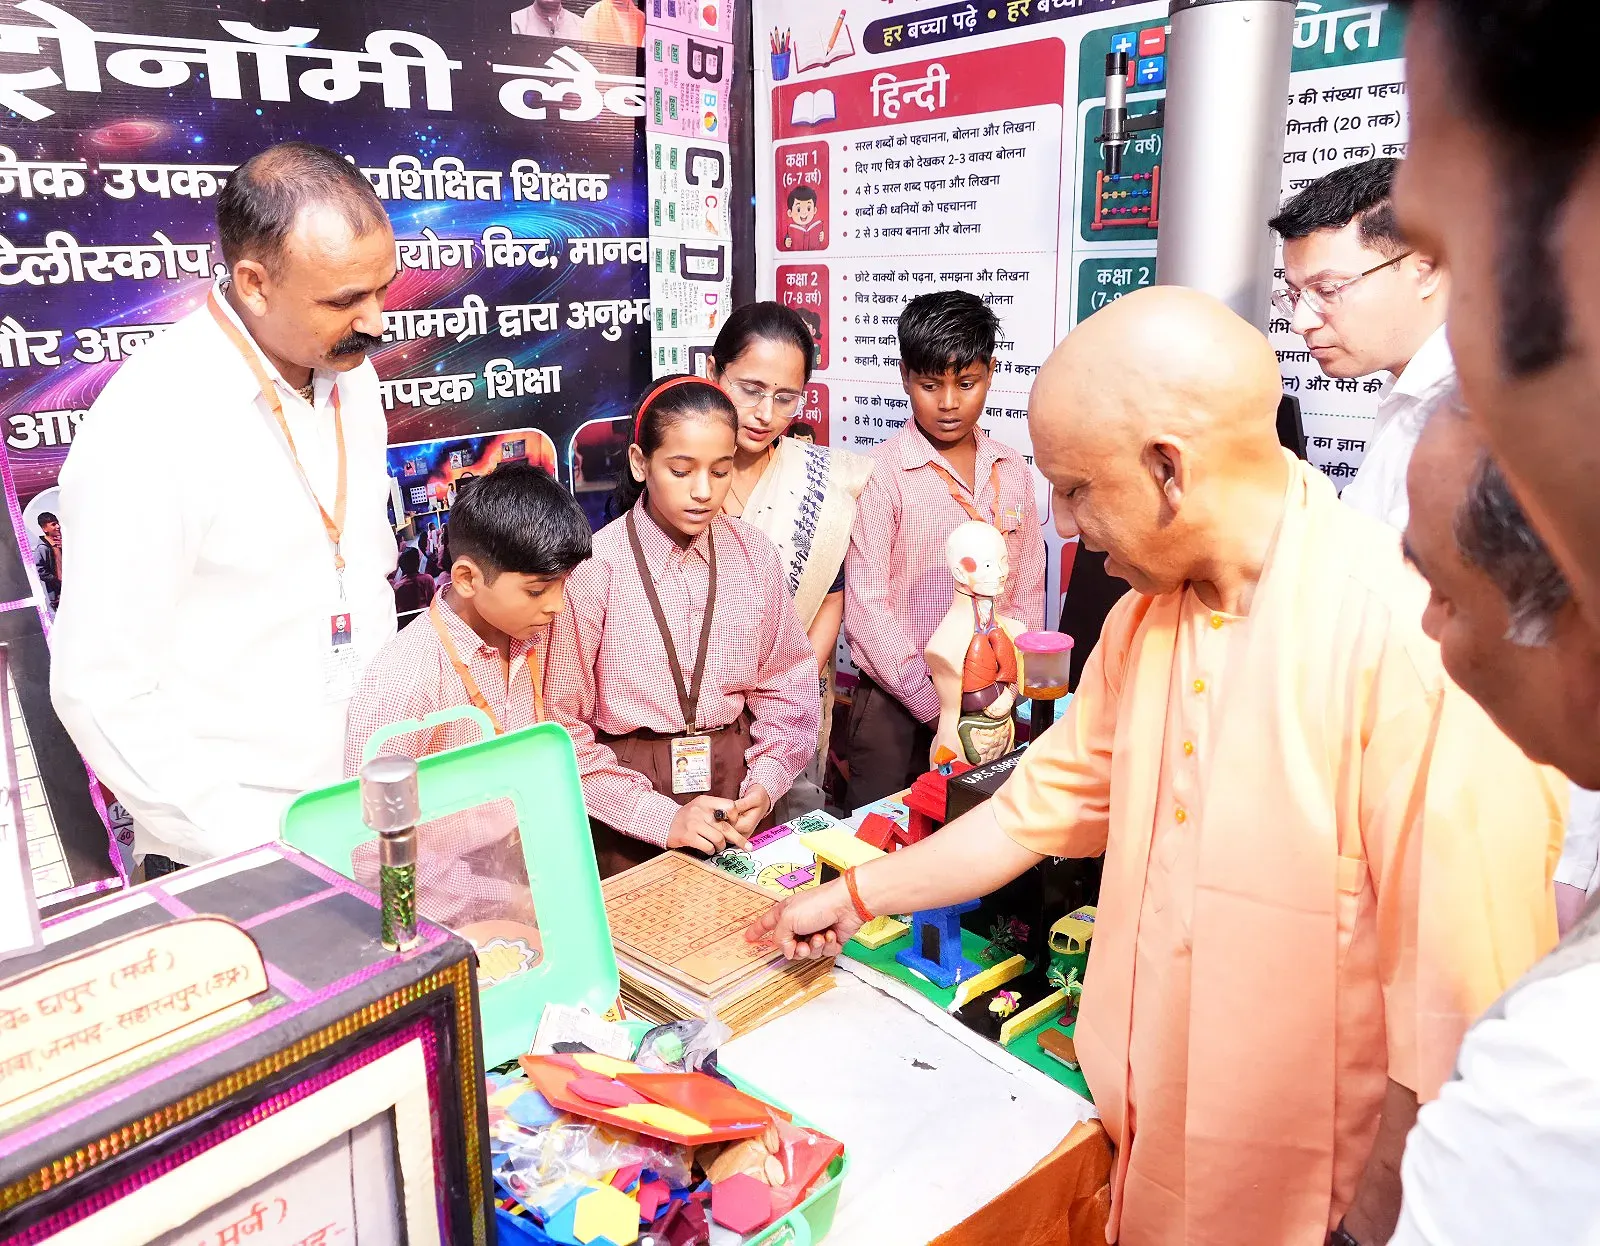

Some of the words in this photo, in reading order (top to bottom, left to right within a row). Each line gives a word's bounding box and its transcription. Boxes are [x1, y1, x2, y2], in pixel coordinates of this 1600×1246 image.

[883, 26, 902, 47] हर
[908, 16, 947, 39] बच्चा
[952, 8, 978, 32] पढ़े
[1006, 0, 1029, 22] हर
[1292, 1, 1389, 54] णित
[687, 38, 723, 83] B
[704, 94, 716, 107] B
[870, 63, 950, 119] हिन्दी
[1299, 88, 1318, 105] की
[1322, 87, 1363, 102] संख्या
[1287, 116, 1328, 135] गिनती
[1334, 116, 1361, 133] (20
[1368, 110, 1400, 128] तक)
[855, 141, 873, 150] सरल
[876, 136, 894, 149] शब्दों
[897, 134, 907, 146] को
[910, 132, 948, 145] पहचानना,
[953, 127, 980, 139] बोलना
[983, 123, 1000, 136] और
[1003, 121, 1035, 134] लिखना
[1135, 134, 1162, 156] वर्ष)
[786, 153, 808, 168] कक्षा
[812, 150, 817, 164] 1
[855, 162, 868, 173] दिए
[872, 163, 882, 172] गए
[885, 159, 900, 170] चित्र
[903, 156, 914, 168] को
[917, 155, 945, 167] देखकर
[949, 154, 965, 164] 2-3
[969, 151, 992, 162] वाक्य
[996, 147, 1025, 159] बोलना
[1313, 148, 1337, 164] (10
[1344, 143, 1375, 159] तक)
[685, 147, 724, 189] C
[99, 163, 238, 199] उपक
[510, 158, 610, 201] शिक्षक
[782, 173, 803, 187] (6-7
[805, 170, 821, 185] वर्ष)
[856, 187, 860, 195] 4
[864, 183, 871, 194] से
[875, 185, 879, 194] 5
[882, 183, 901, 193] सरल
[904, 182, 921, 191] शब्द
[924, 180, 946, 191] पढ़ना
[949, 175, 965, 188] और
[968, 174, 1000, 186] लिखना
[705, 196, 717, 208] C
[856, 205, 874, 216] शब्दों
[877, 204, 887, 215] की
[891, 202, 919, 214] ध्वनियों
[922, 201, 934, 212] को
[937, 201, 977, 212] पहचानना
[856, 229, 860, 238] 2
[863, 227, 870, 238] से
[874, 229, 878, 237] 3
[882, 228, 903, 237] वाक्य
[906, 226, 930, 235] बनाना
[934, 222, 950, 234] और
[953, 222, 981, 233] बोलना
[396, 227, 474, 271] योग
[481, 225, 559, 269] किट,
[680, 244, 724, 282] D
[786, 273, 808, 286] कक्षा
[811, 272, 818, 286] 2
[855, 271, 870, 282] छोटे
[873, 270, 895, 281] वाक्यों
[898, 270, 909, 281] को
[912, 273, 936, 283] पढ़ना,
[940, 273, 973, 282] समझना
[977, 269, 993, 281] और
[996, 269, 1029, 281] लिखना
[1097, 269, 1133, 286] कक्षा
[1138, 266, 1150, 284] 2
[704, 294, 717, 305] D
[783, 291, 803, 305] (7-8
[805, 291, 822, 306] वर्ष)
[855, 292, 869, 303] चित्र
[872, 292, 899, 304] देखकर
[496, 303, 559, 338] द्वारा
[855, 315, 860, 324] 6
[863, 313, 870, 324] से
[873, 316, 878, 324] 8
[855, 336, 876, 344] समान
[879, 334, 896, 345] ध्वनि
[854, 354, 880, 367] कहानी,
[1004, 361, 1012, 373] में
[483, 358, 562, 399] शिक्षा
[1305, 375, 1330, 391] और
[812, 390, 818, 404] 3
[854, 396, 869, 405] पाठ
[871, 395, 882, 406] को
[884, 398, 908, 410] पढ़कर
[986, 406, 1002, 417] बात
[806, 407, 822, 423] वर्ष)
[854, 416, 860, 424] 8
[863, 414, 870, 426] से
[873, 418, 883, 428] 10
[1313, 437, 1333, 449] का
[1337, 439, 1366, 452] ज्ञान
